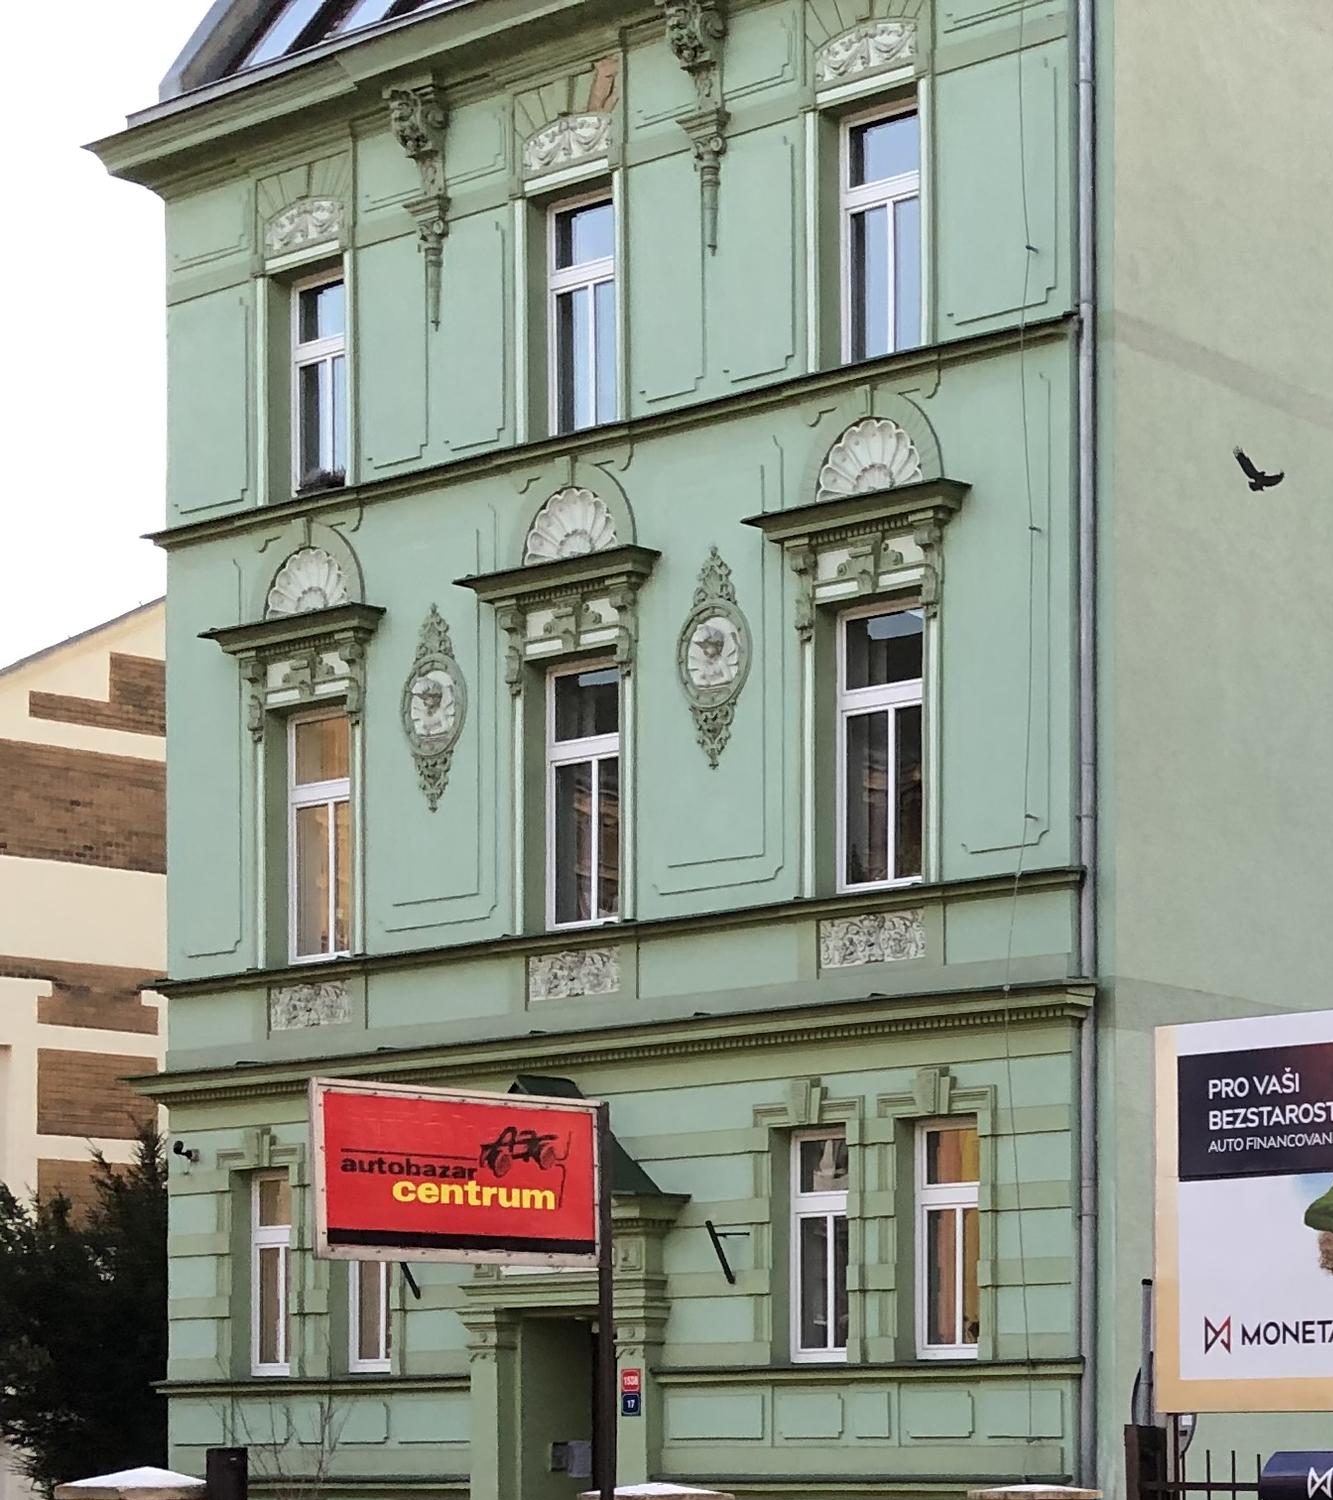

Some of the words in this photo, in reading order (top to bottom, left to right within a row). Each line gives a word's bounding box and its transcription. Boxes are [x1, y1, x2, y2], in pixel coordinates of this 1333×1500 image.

[1208, 1077, 1249, 1100] PRO
[1253, 1067, 1300, 1095] VAŠI
[1208, 1137, 1244, 1153] AUTO
[340, 1156, 477, 1180] autobazar
[392, 1180, 555, 1211] centrum
[627, 1399, 636, 1409] 17
